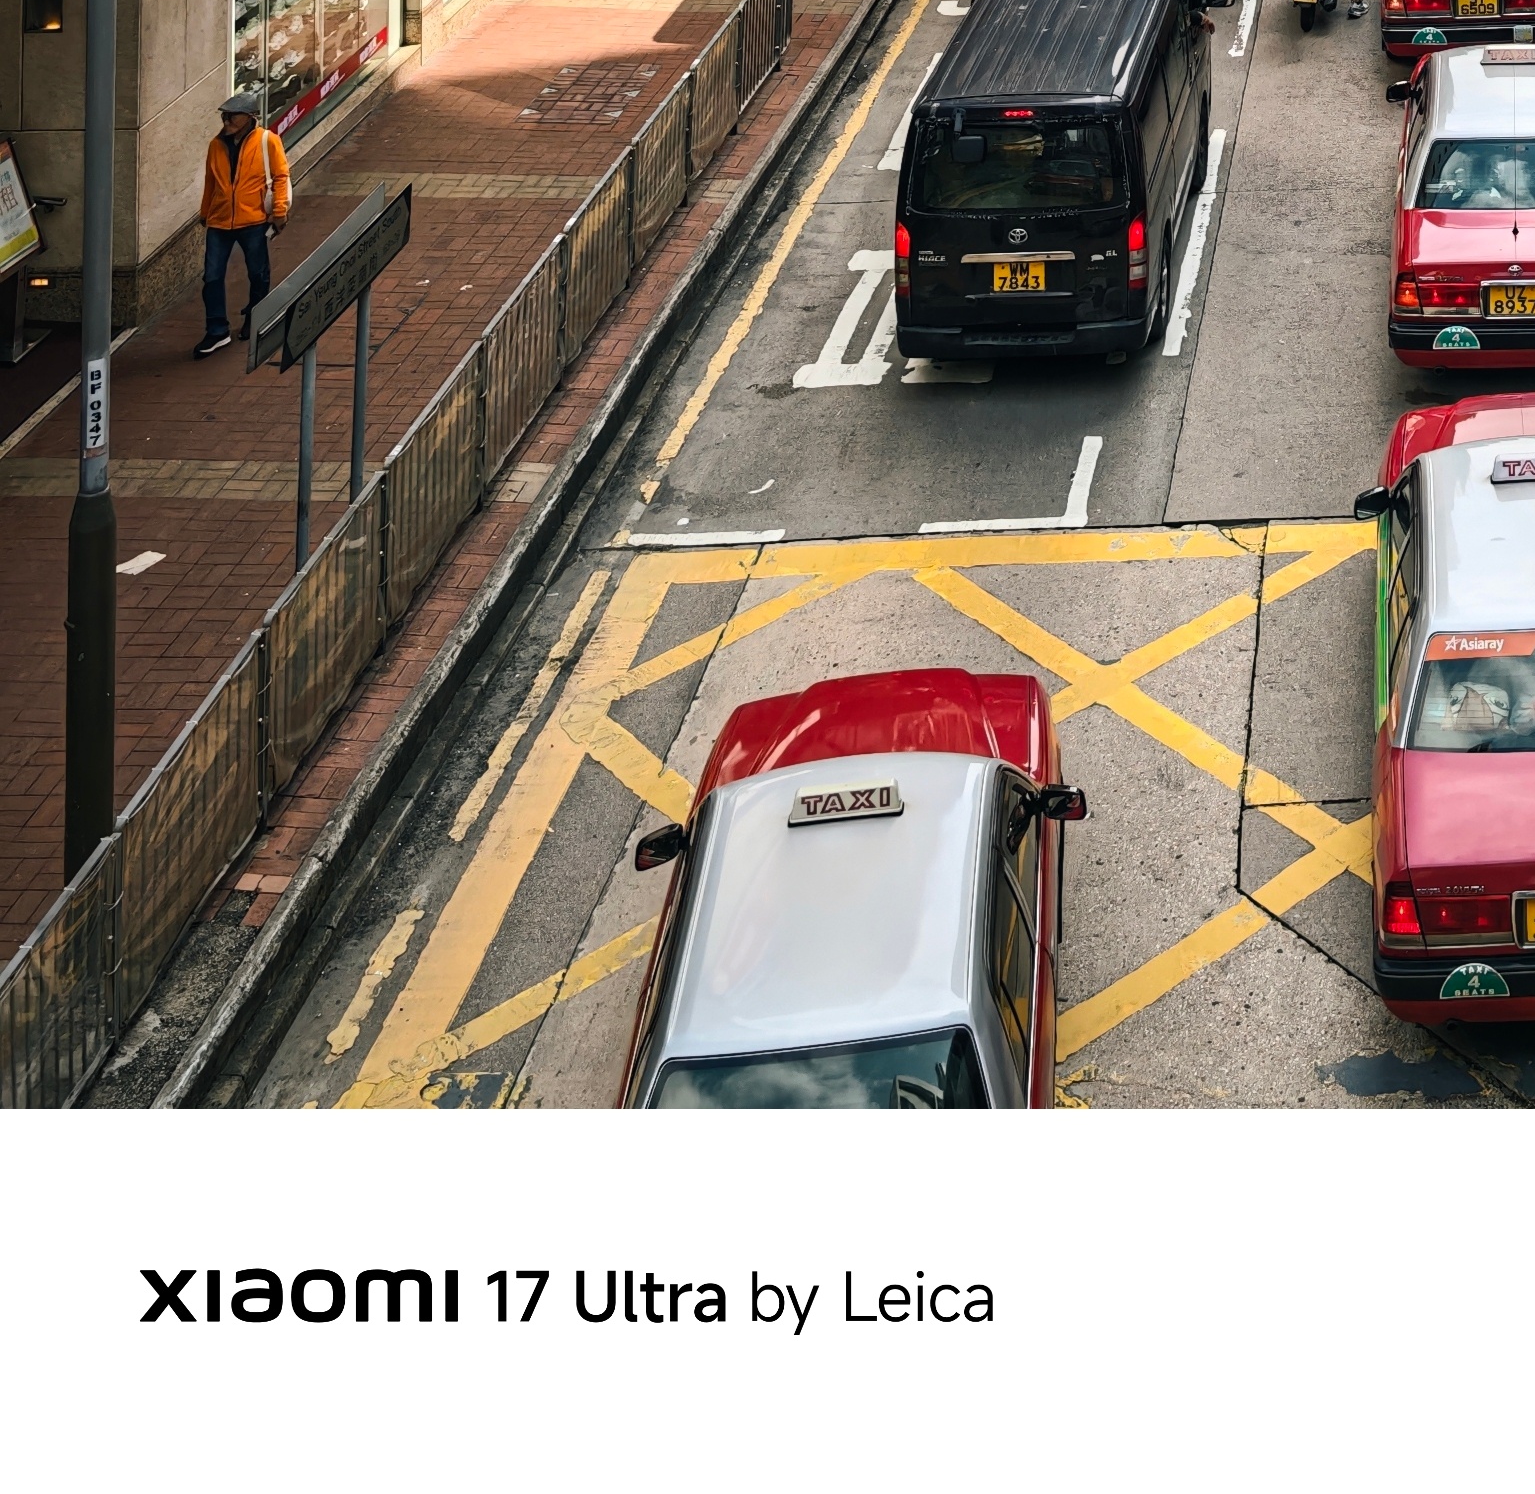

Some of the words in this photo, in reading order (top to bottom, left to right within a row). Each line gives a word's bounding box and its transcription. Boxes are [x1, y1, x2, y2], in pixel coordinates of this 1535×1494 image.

[1461, 3, 1495, 15] 6509
[1009, 263, 1030, 277] WM
[998, 276, 1041, 290] 7843
[1504, 285, 1527, 300] UZ
[1451, 334, 1460, 342] 4
[89, 399, 102, 447] 0347
[1459, 635, 1505, 654] Asiaray
[800, 786, 892, 815] TAXI
[1459, 965, 1489, 976] TAXI
[1467, 976, 1481, 989] 4
